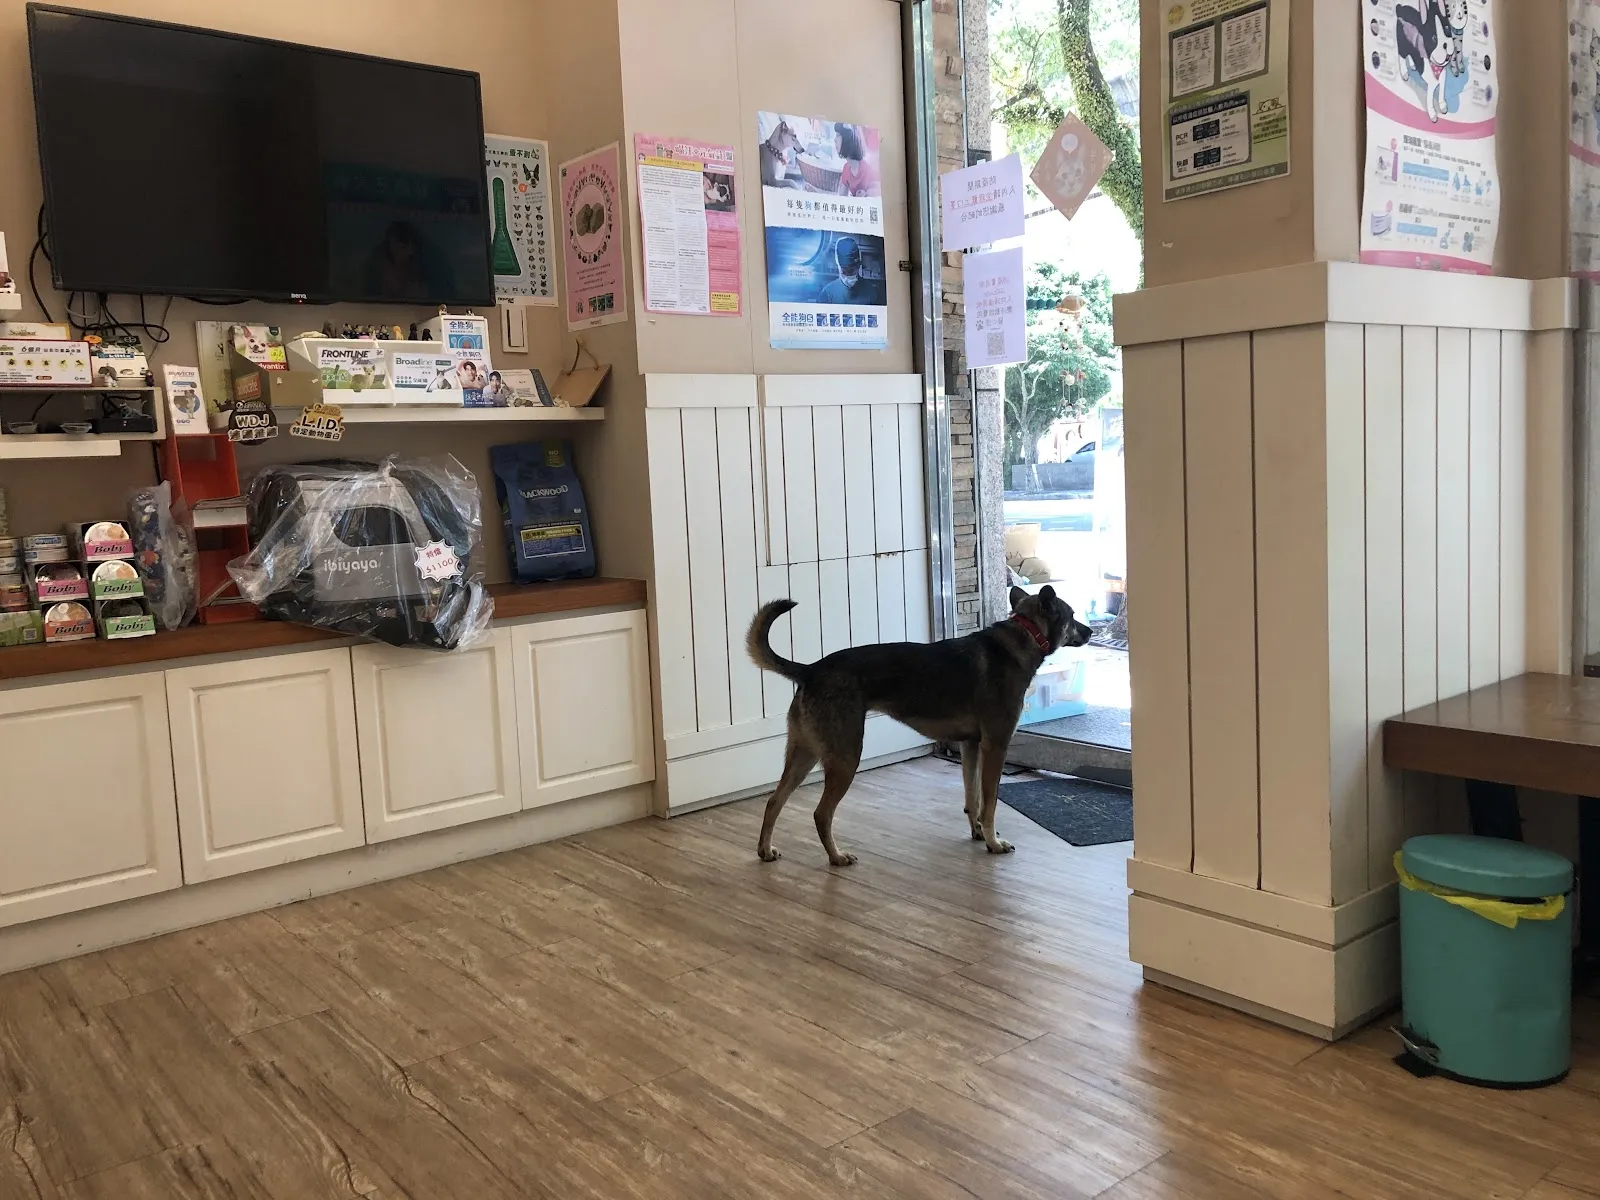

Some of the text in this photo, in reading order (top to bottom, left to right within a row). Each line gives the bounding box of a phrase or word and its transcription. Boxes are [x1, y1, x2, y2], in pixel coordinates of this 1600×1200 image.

[1175, 132, 1188, 141] PCR
[786, 198, 864, 216] 每隻狗都值得最好的
[321, 349, 369, 358] FRONTLINE
[260, 361, 286, 370] dvantix
[396, 357, 433, 366] Broadline
[235, 413, 270, 428] WDJ
[301, 415, 338, 431] L.I.D.
[291, 426, 340, 440] 特定動物蛋白
[324, 558, 378, 574] ibiyaya
